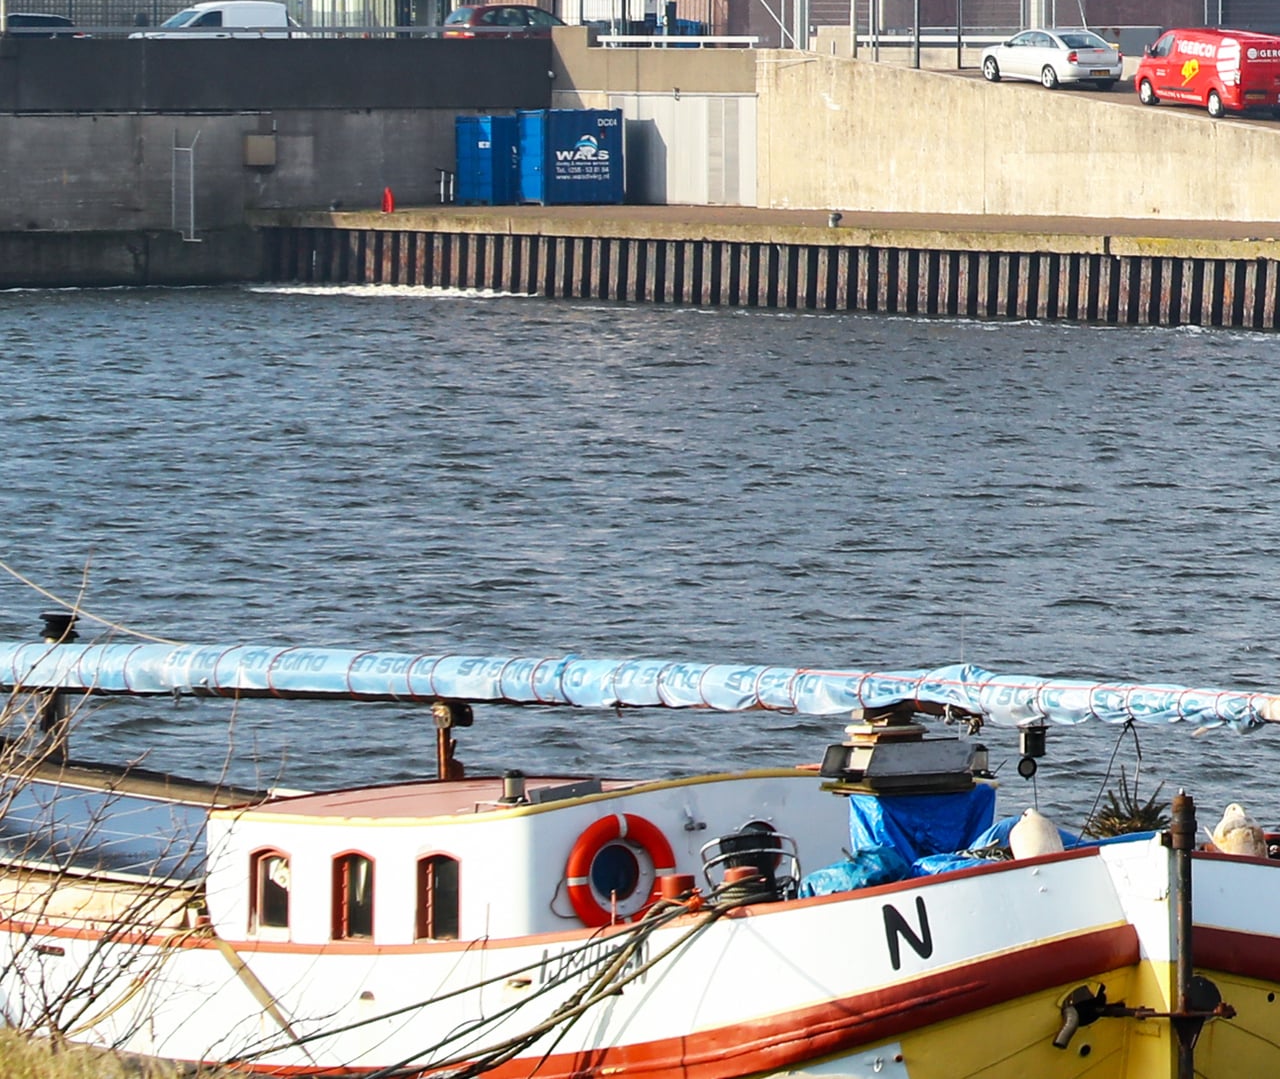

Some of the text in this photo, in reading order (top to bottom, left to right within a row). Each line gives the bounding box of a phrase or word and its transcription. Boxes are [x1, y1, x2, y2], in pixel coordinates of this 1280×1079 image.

[1181, 40, 1212, 58] GERCO
[556, 150, 610, 161] WALS
[882, 895, 933, 971] N
